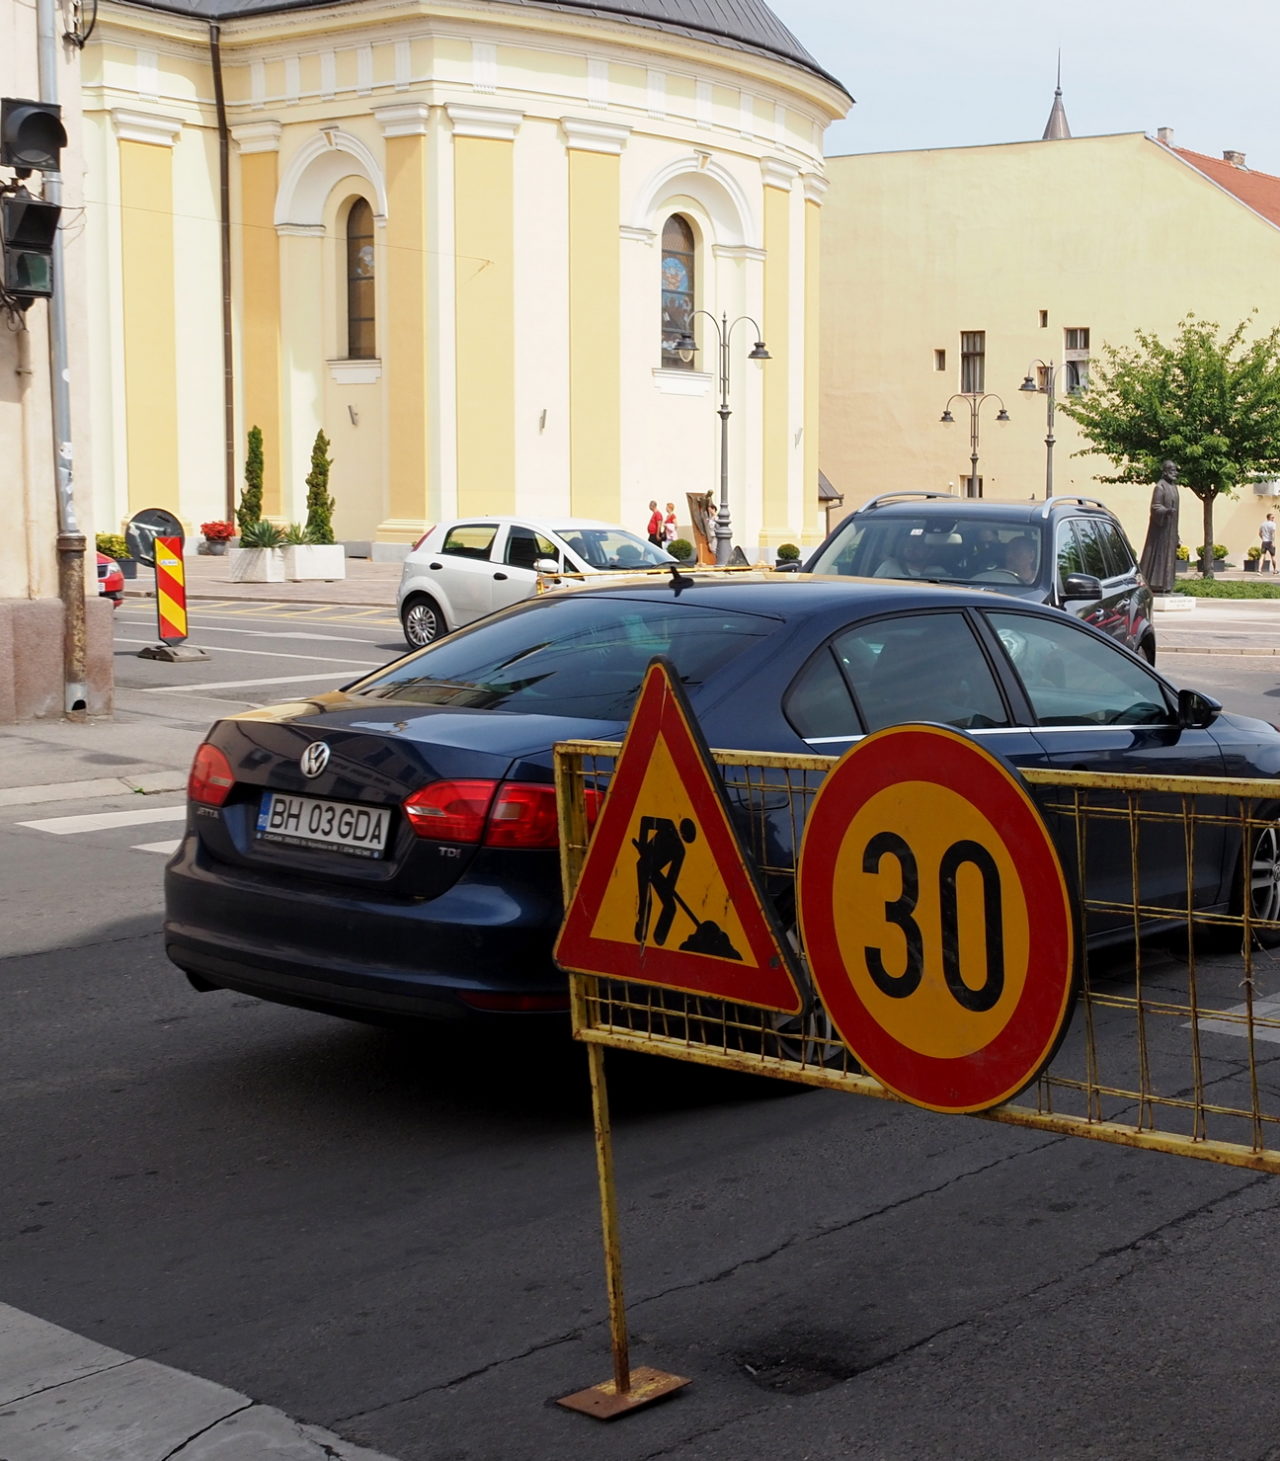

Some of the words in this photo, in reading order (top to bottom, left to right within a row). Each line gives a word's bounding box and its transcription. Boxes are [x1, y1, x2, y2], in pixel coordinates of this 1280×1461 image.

[270, 799, 304, 831] BH
[438, 846, 461, 859] TDI
[862, 831, 1005, 1013] 30
